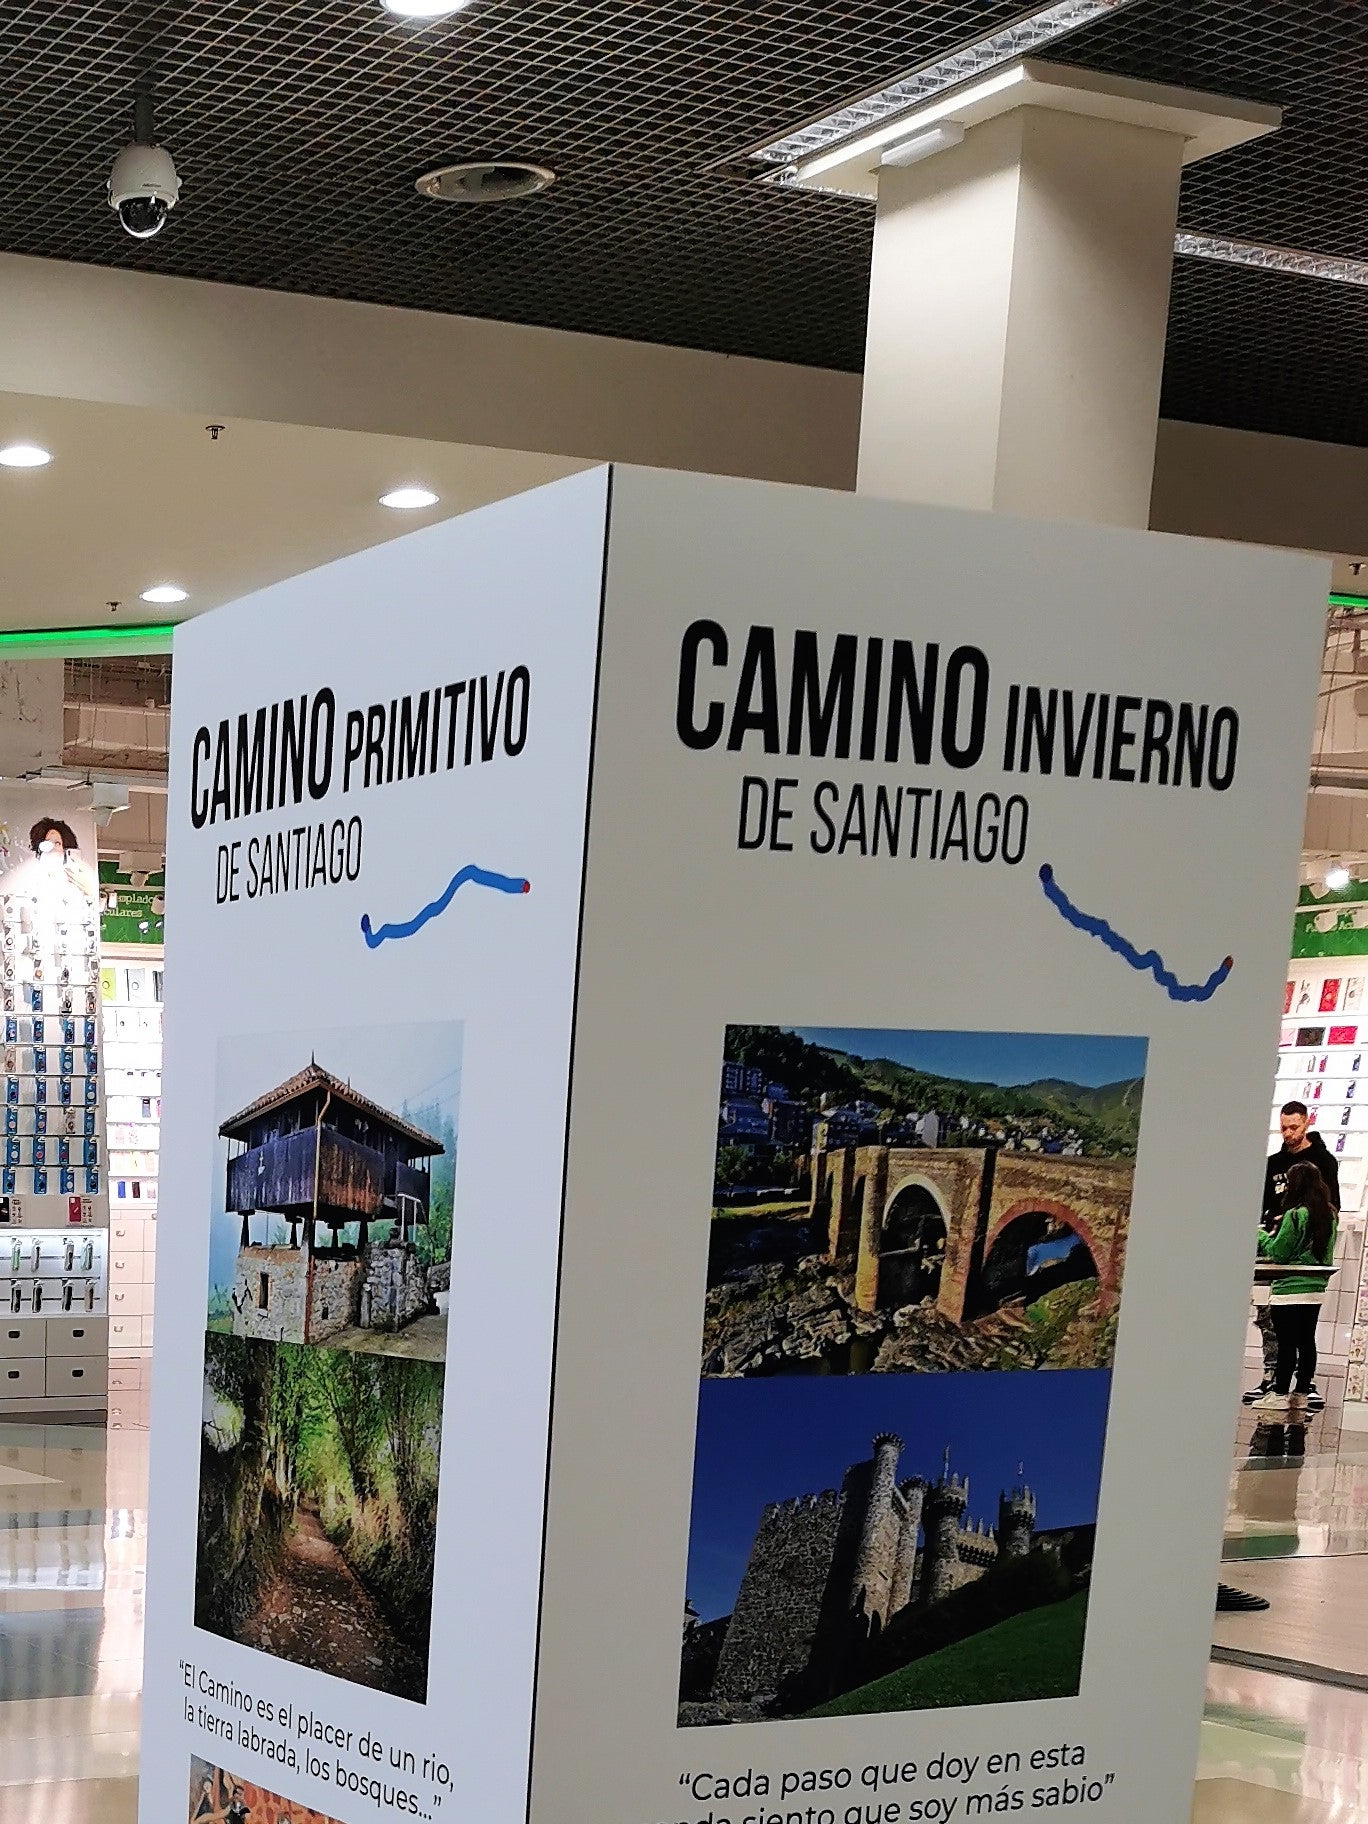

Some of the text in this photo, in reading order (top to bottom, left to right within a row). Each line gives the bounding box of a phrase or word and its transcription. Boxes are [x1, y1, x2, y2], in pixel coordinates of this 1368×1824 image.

[191, 665, 531, 829] CAMINO PRIMITIVO
[675, 618, 1240, 791] CAMINO INVIERNO
[216, 815, 363, 905] DE SANTIAGO
[737, 775, 1030, 865] DE SANTIAGO
[179, 1659, 195, 1688] “El
[198, 1671, 252, 1713] Camino
[257, 1699, 274, 1722] es
[278, 1703, 293, 1729] el
[297, 1711, 353, 1751] placer
[358, 1732, 383, 1762] de
[389, 1746, 415, 1774] un
[184, 1696, 195, 1723] la
[198, 1704, 233, 1741] tierra
[237, 1720, 300, 1775] labrada,
[305, 1748, 330, 1781] los
[678, 1743, 1086, 1801] “Cada paso que doy en esta
[909, 1795, 958, 1824] soy
[964, 1785, 1025, 1815] más
[1031, 1773, 1116, 1809] sabio”
